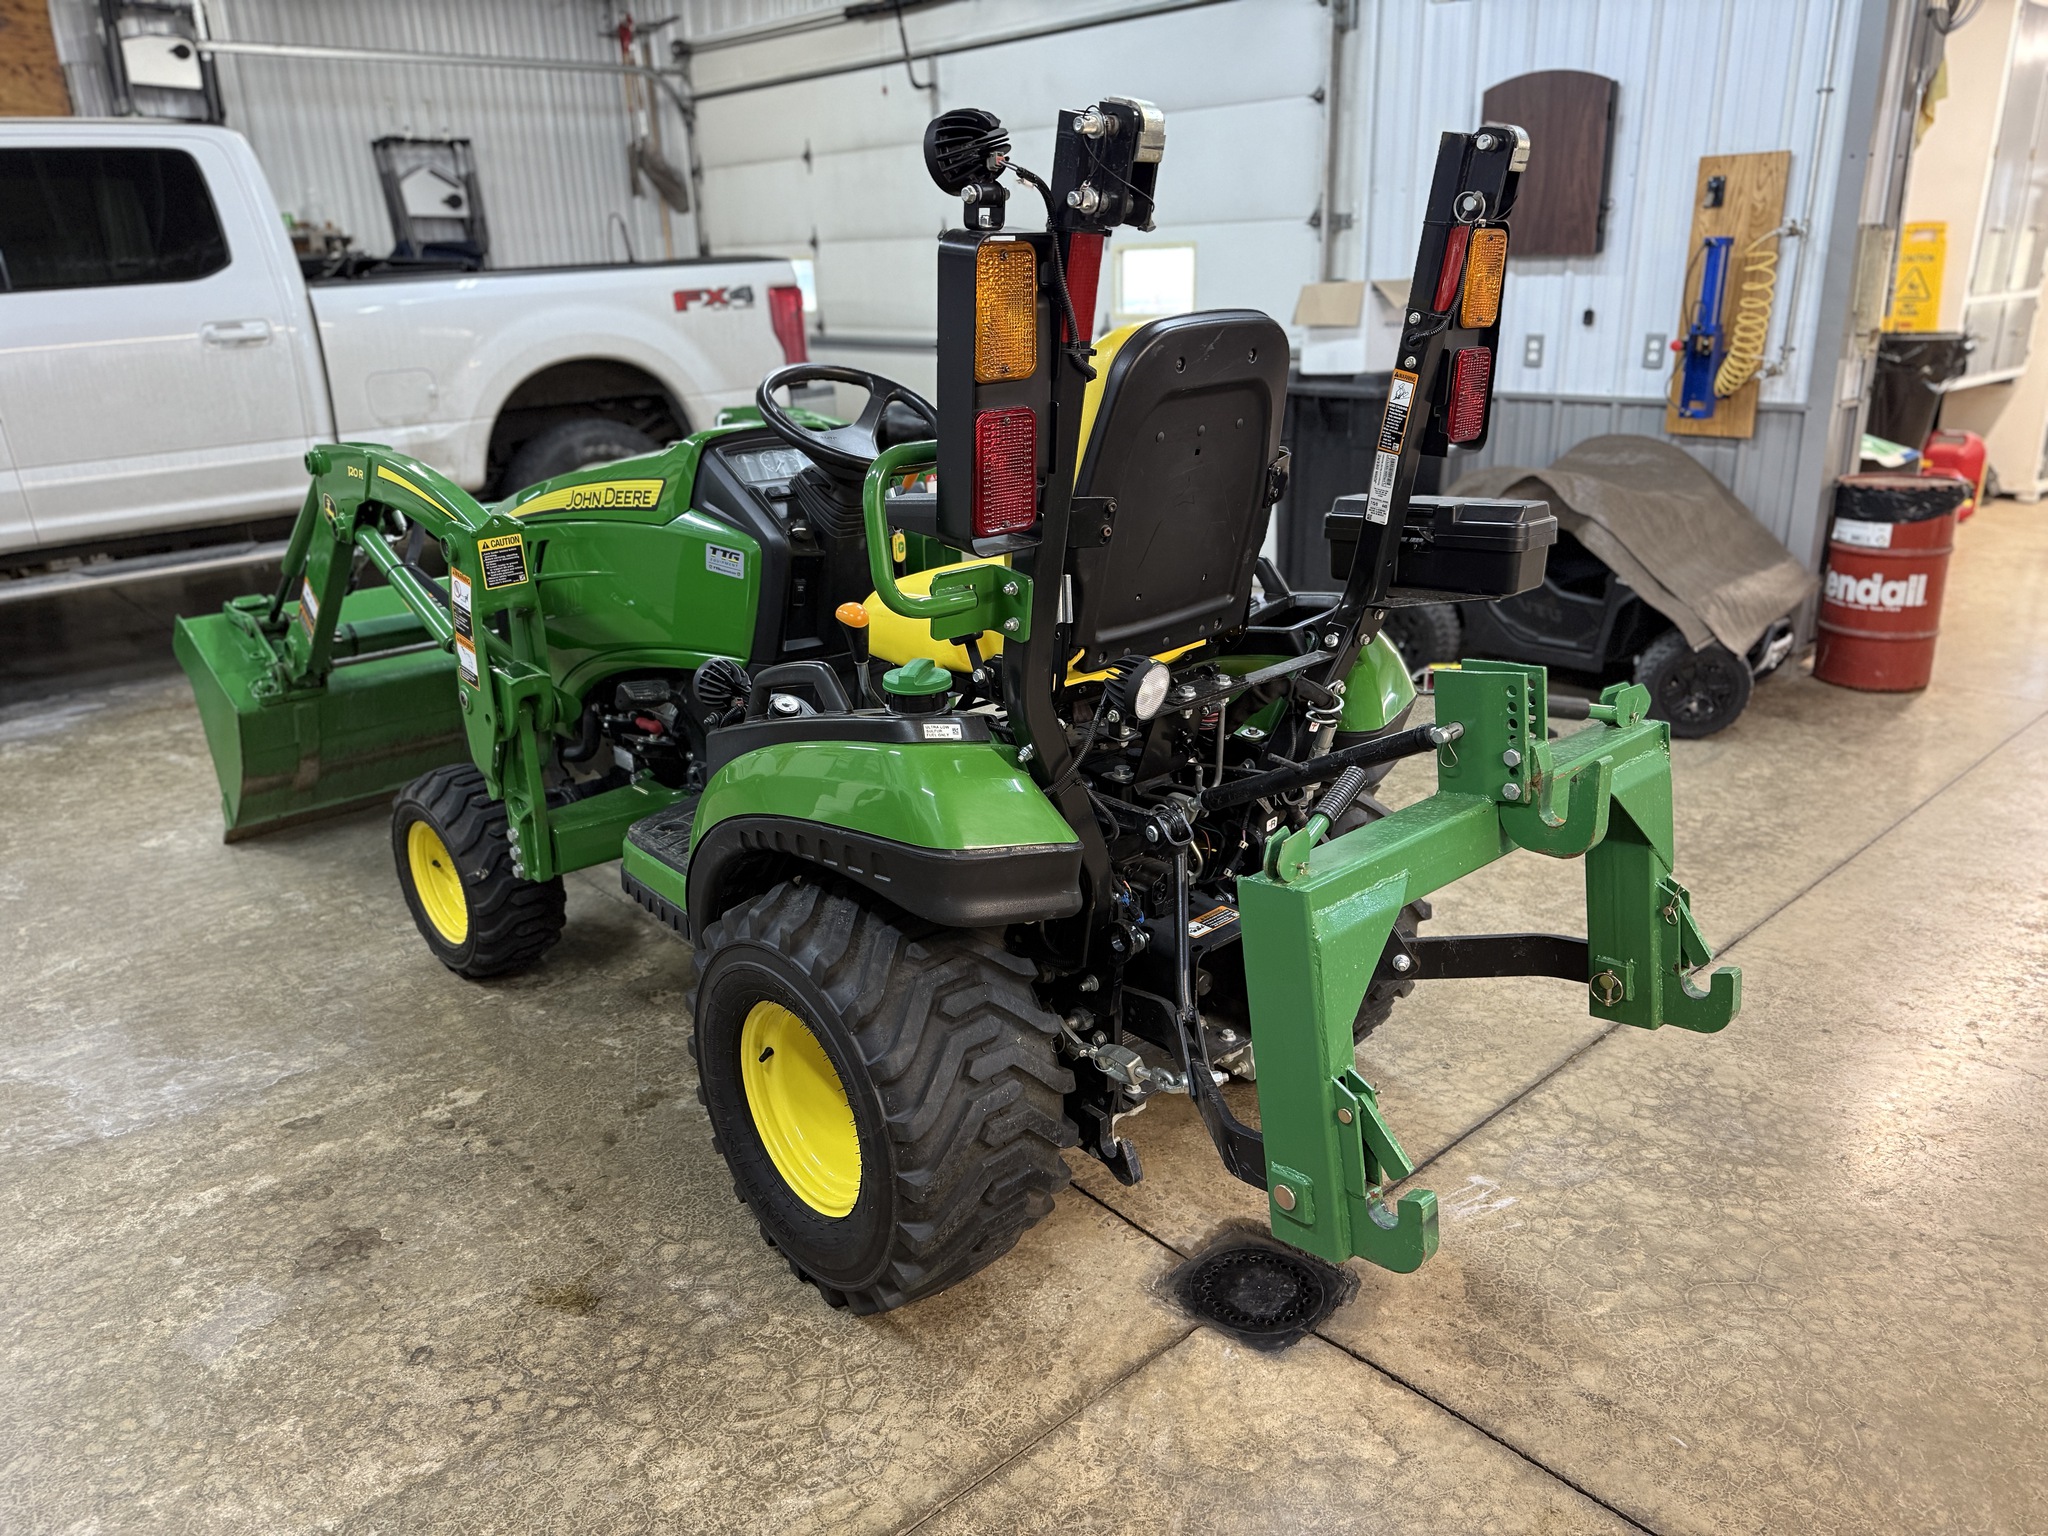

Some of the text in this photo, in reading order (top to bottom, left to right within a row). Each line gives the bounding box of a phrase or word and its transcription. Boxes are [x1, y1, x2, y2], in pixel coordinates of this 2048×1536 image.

[674, 286, 754, 312] FX4
[566, 487, 652, 508] JOHN DEERE
[490, 535, 520, 548] CAUTION
[709, 546, 740, 563] TTG
[1825, 571, 1928, 607] endall
